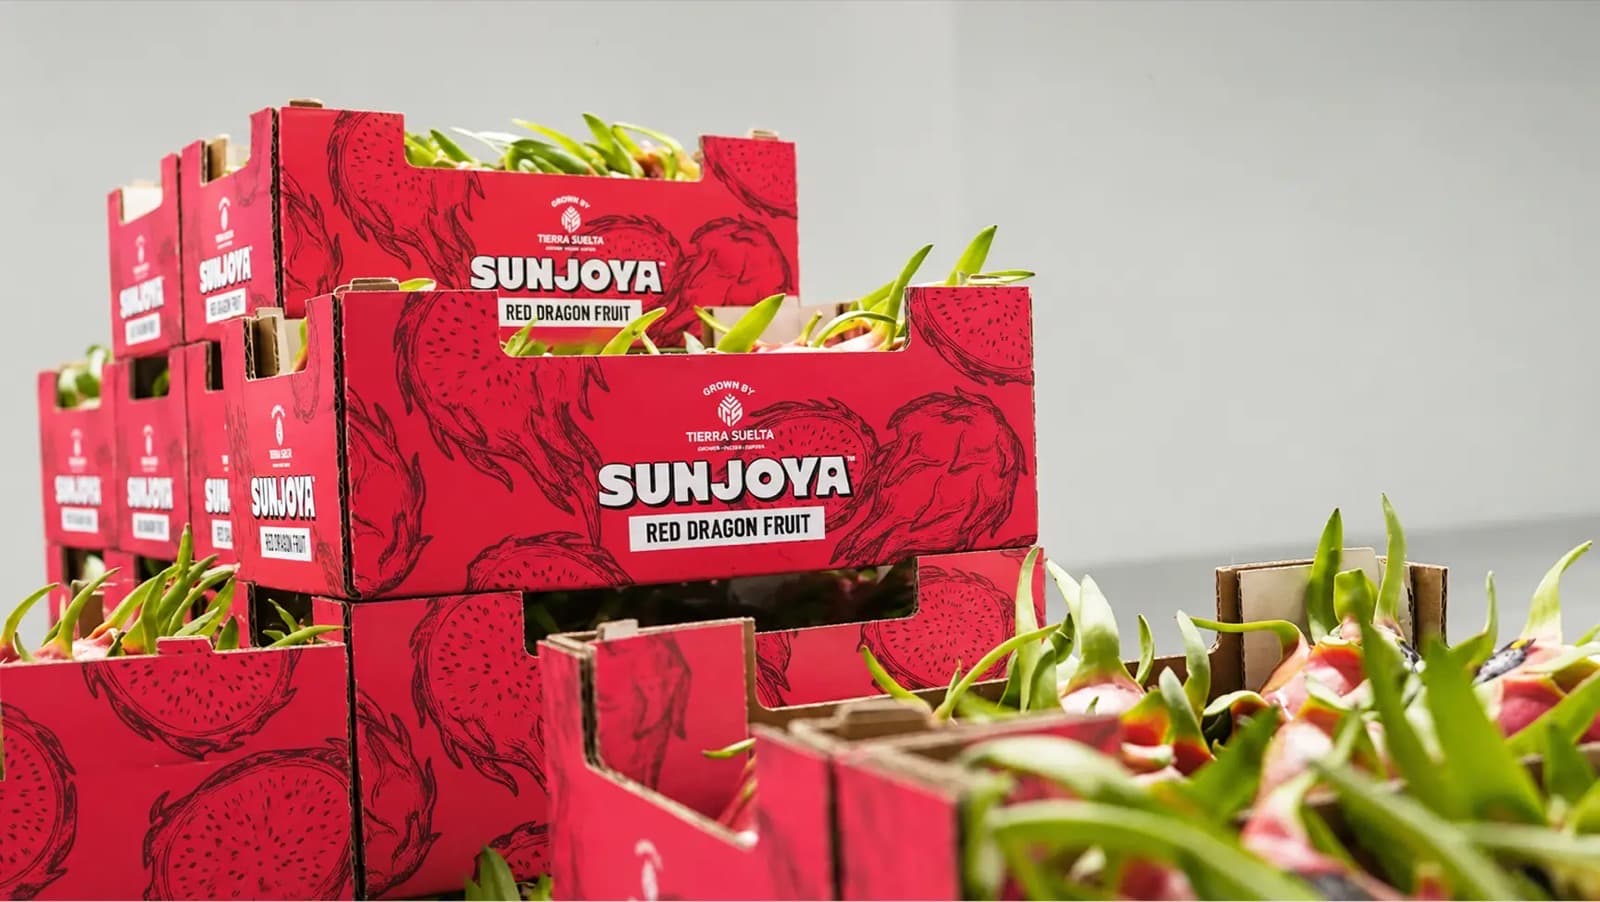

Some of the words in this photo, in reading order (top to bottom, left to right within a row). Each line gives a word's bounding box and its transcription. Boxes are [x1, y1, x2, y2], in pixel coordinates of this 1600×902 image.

[537, 234, 570, 244] TIERRA
[571, 235, 604, 245] SUELTA
[470, 256, 664, 293] SUNJOYA
[506, 304, 532, 321] RED
[536, 305, 590, 321] DRAGON
[594, 306, 631, 321] FRUIT
[703, 381, 740, 396] GROWN
[741, 384, 756, 396] BY
[686, 431, 729, 442] TIERRA
[731, 429, 774, 441] SUELTA
[598, 455, 854, 510] SUNJOYA
[251, 475, 317, 521] SUNJOYA
[646, 521, 681, 543] RED
[687, 517, 757, 541] DRAGON
[763, 513, 811, 535] FRUIT
